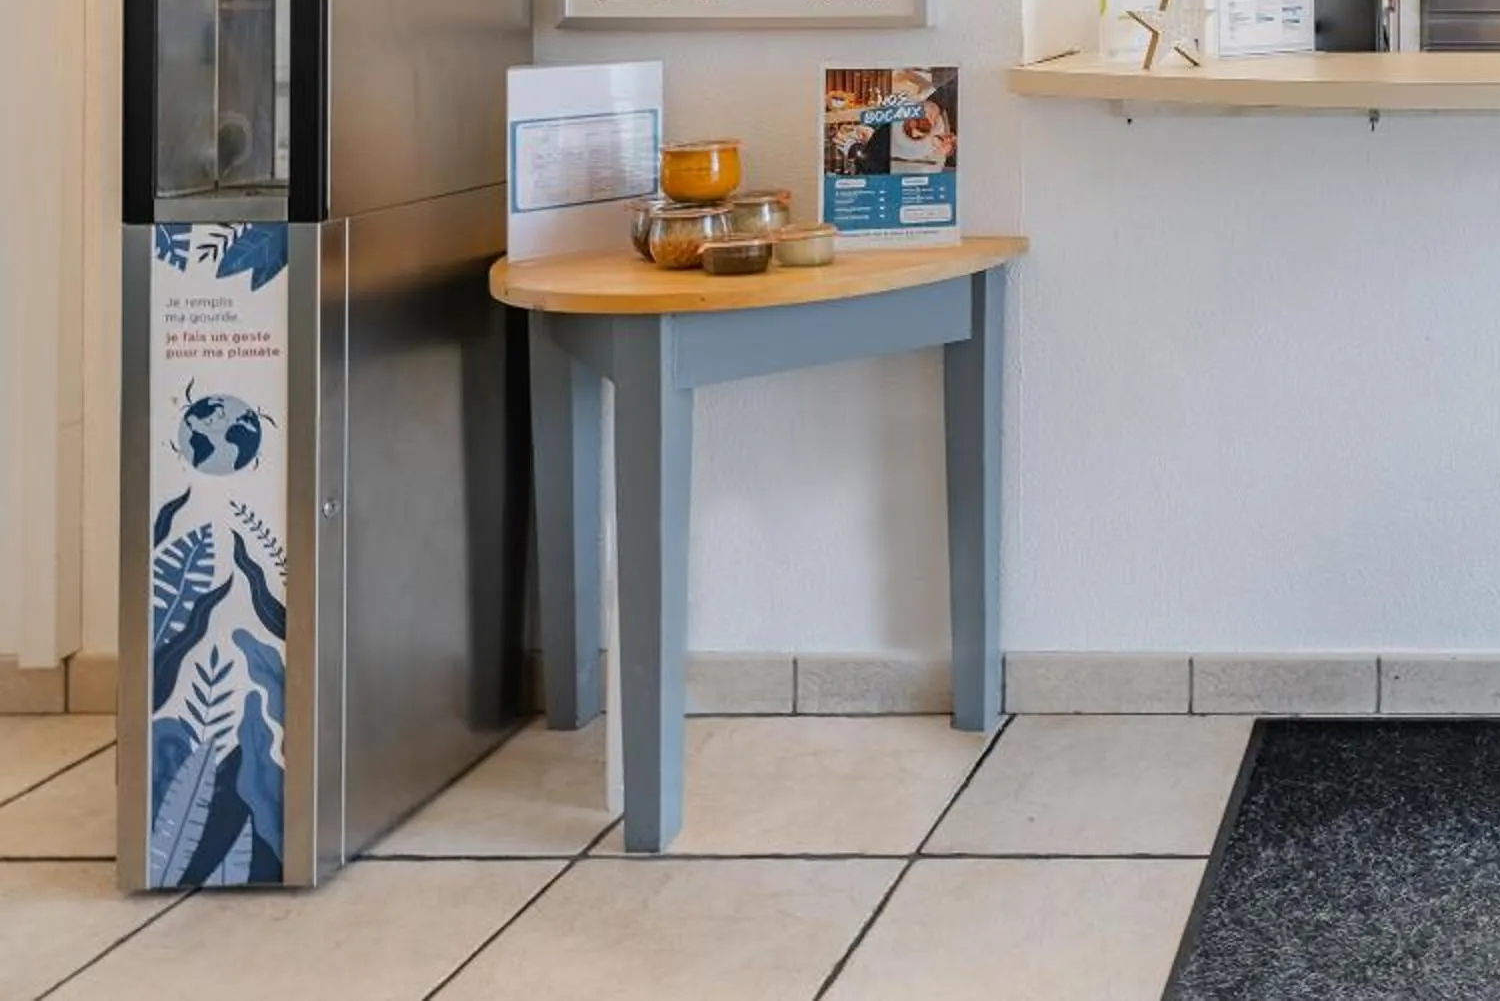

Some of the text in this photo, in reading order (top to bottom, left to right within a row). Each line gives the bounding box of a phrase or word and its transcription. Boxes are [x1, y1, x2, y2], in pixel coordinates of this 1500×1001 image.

[211, 333, 228, 342] un
[166, 348, 197, 359] pour
[203, 349, 224, 358] ma
